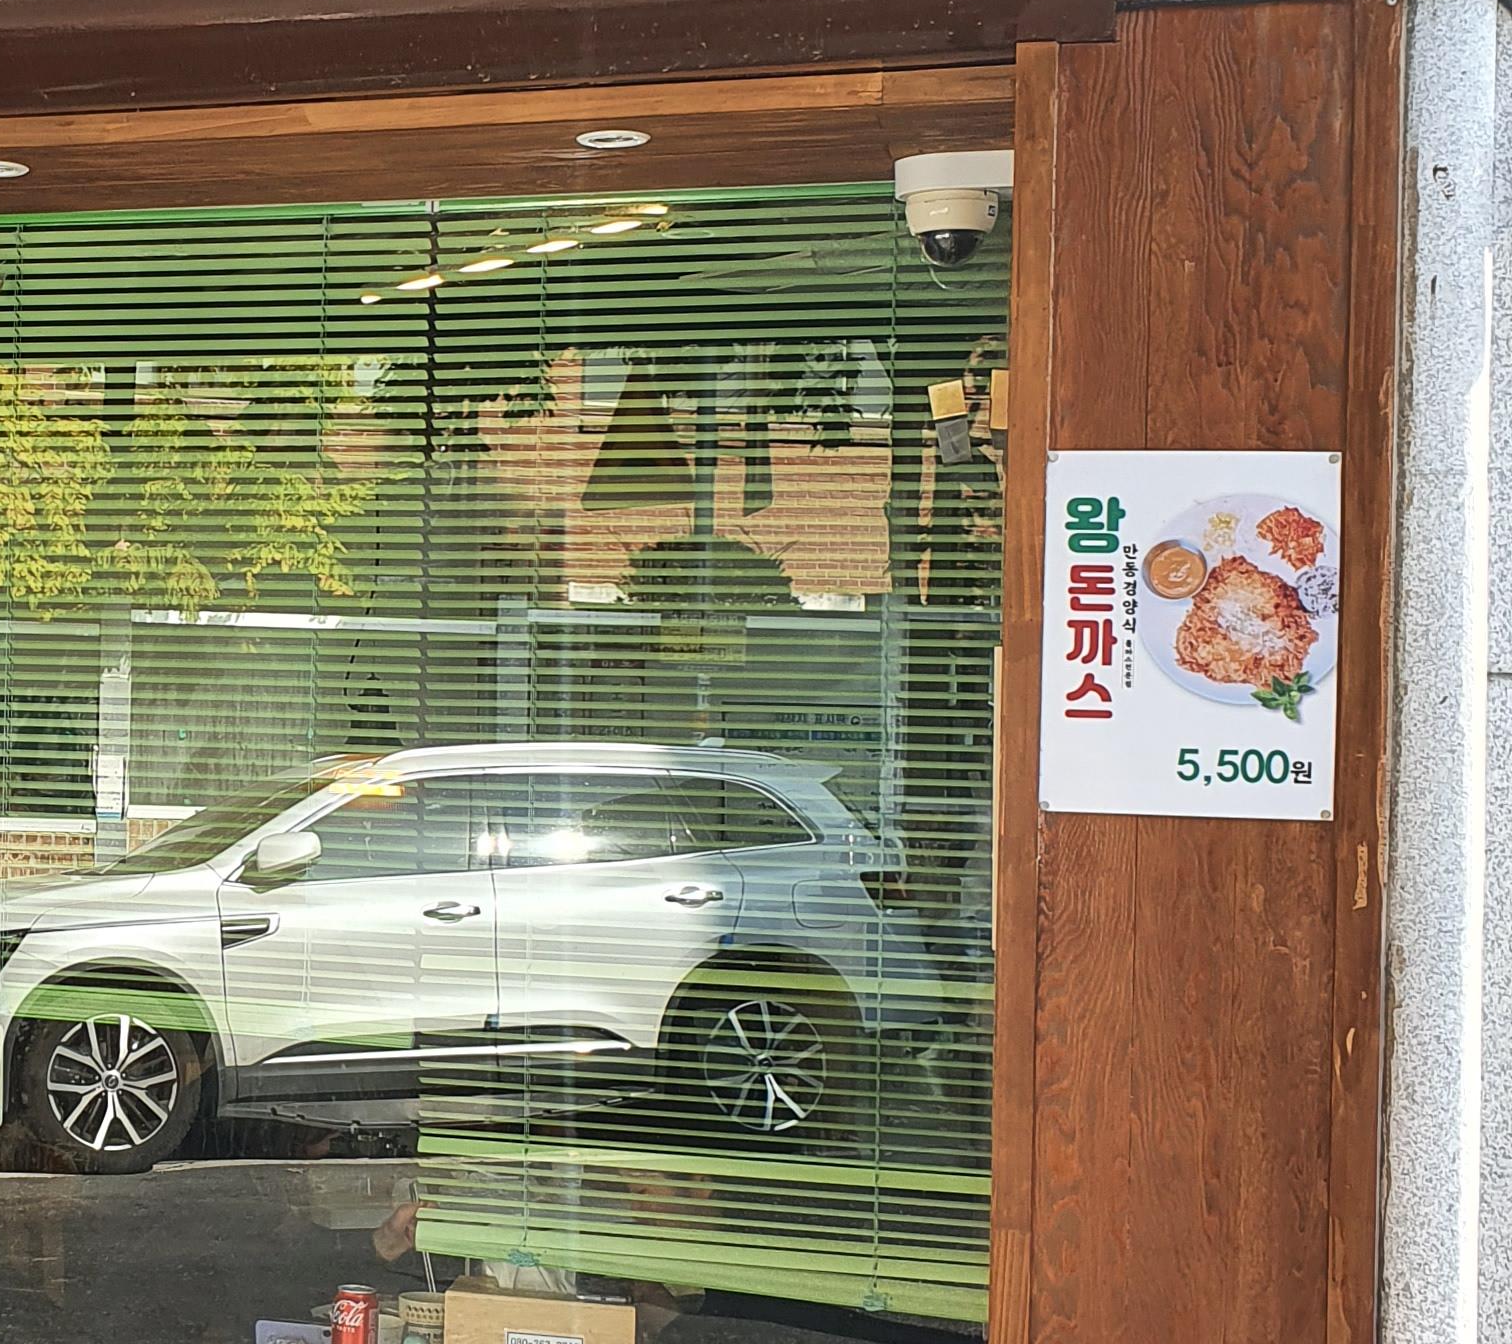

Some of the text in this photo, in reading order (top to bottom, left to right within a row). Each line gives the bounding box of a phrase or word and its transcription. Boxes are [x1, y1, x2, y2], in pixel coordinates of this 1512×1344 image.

[1065, 496, 1126, 718] 왕돈까스
[1121, 544, 1138, 634] 만동경양식
[1176, 747, 1312, 785] 5,500원
